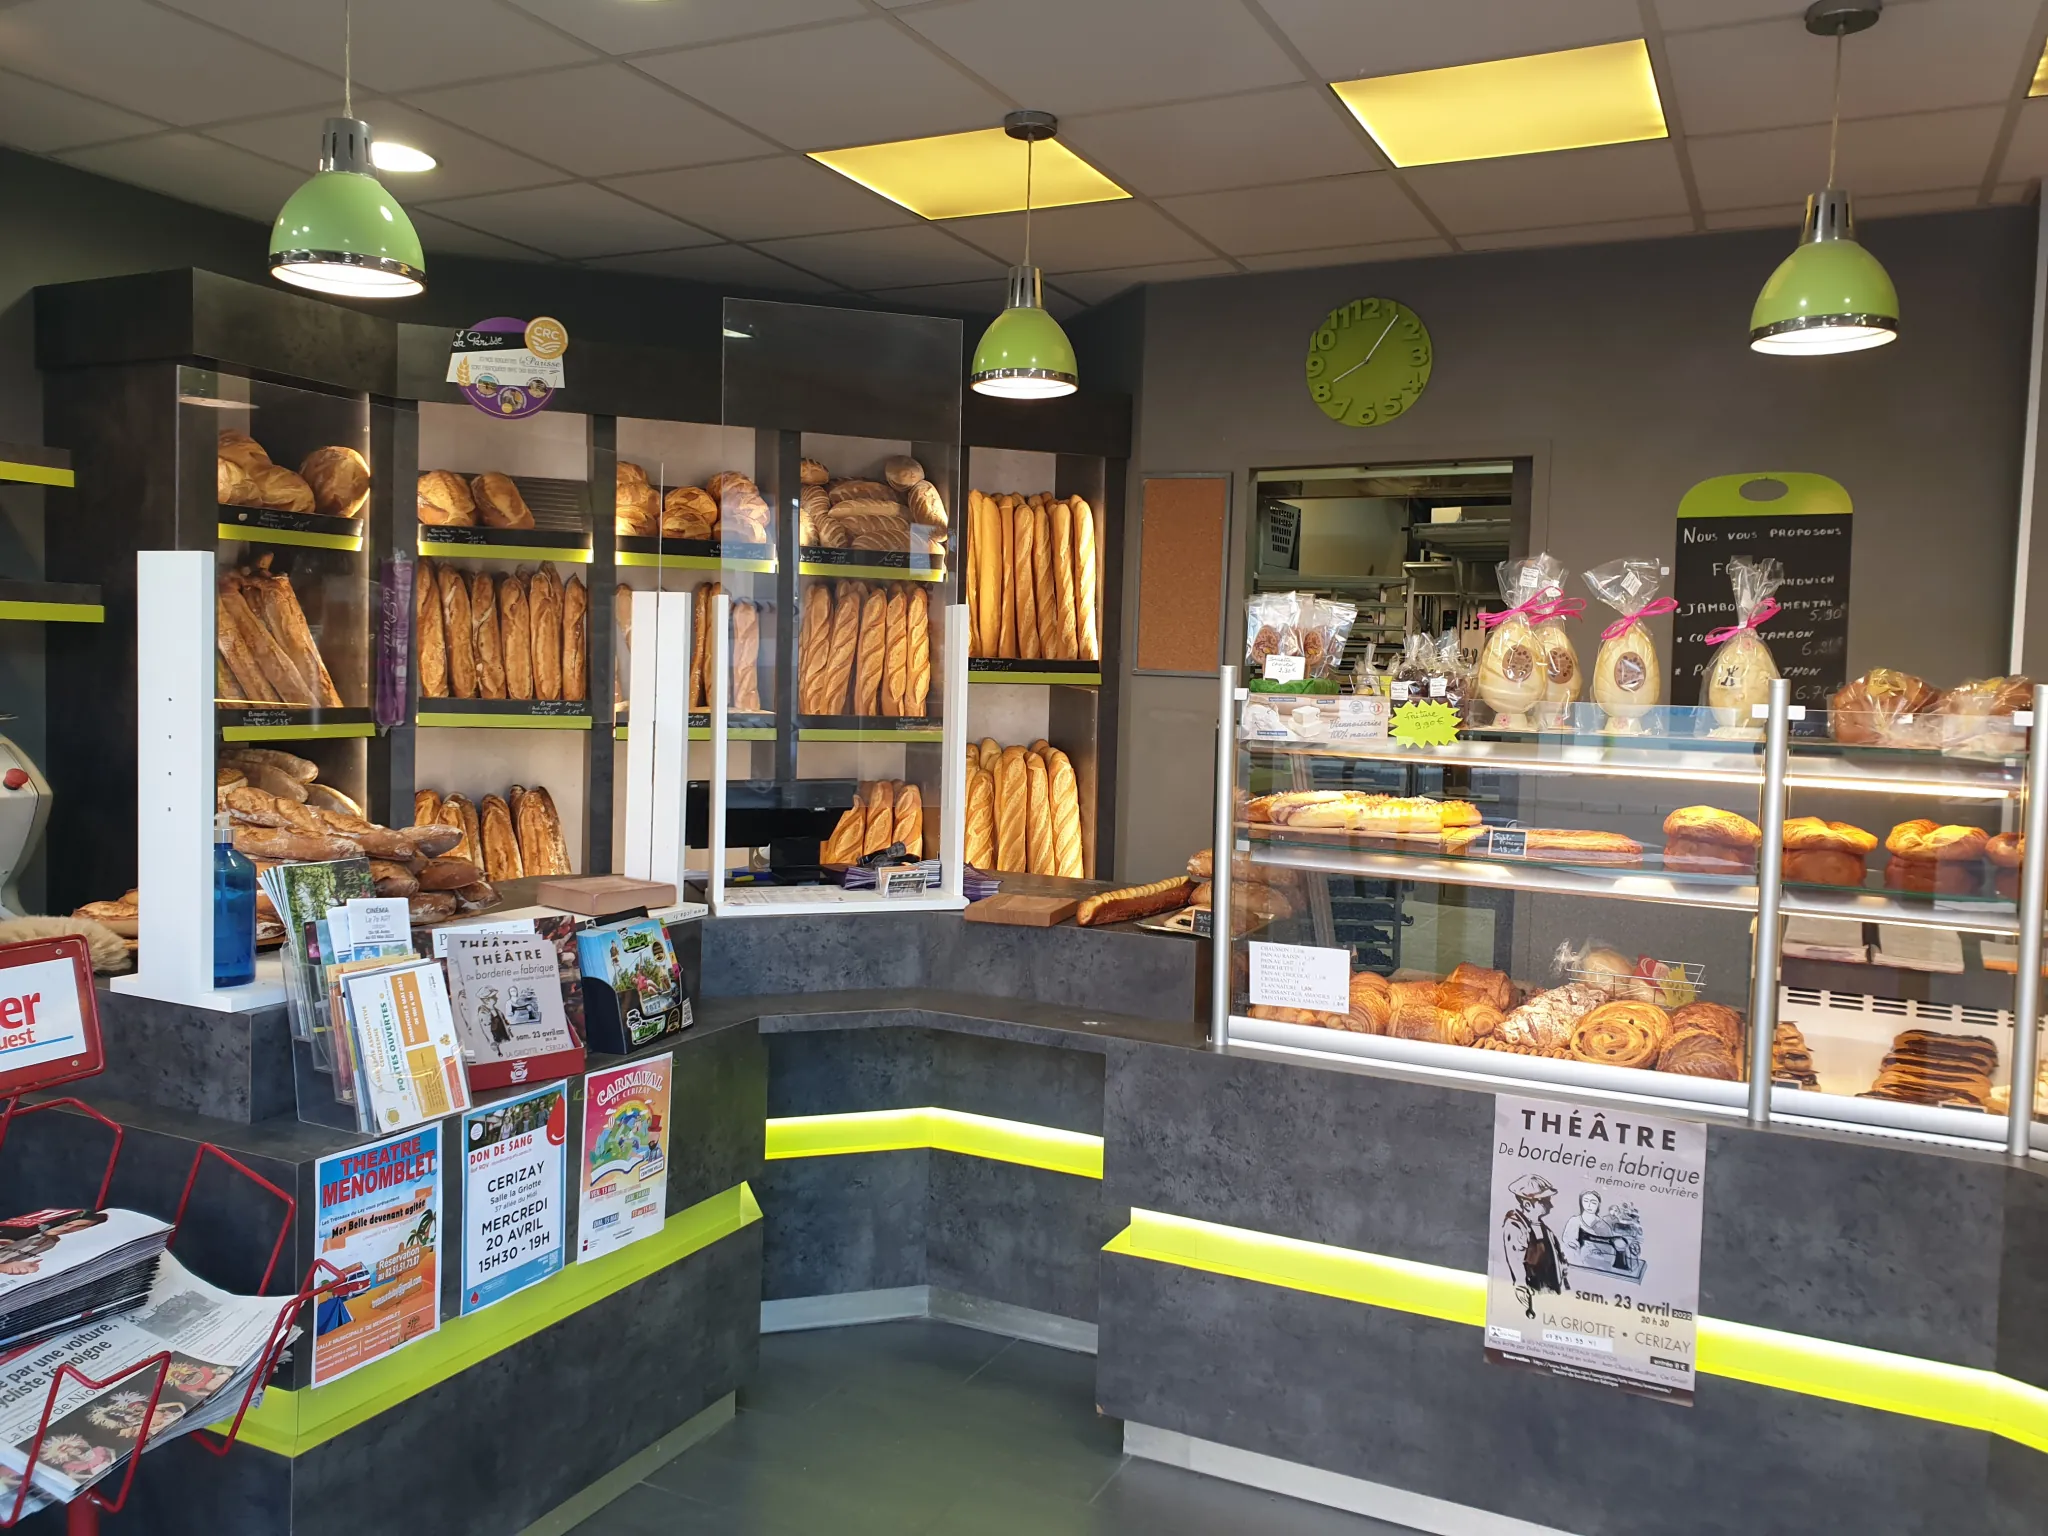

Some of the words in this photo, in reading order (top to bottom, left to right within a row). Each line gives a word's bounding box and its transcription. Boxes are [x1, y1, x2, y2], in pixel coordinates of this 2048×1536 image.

[1327, 308, 1350, 329] 11
[1351, 298, 1380, 320] 12
[1387, 301, 1398, 320] 1
[533, 327, 560, 340] CRC
[1310, 329, 1336, 352] 10
[1402, 320, 1421, 341] 2
[1306, 357, 1325, 378] 9
[1409, 346, 1429, 367] 3
[1312, 381, 1332, 403] 8
[1401, 372, 1423, 394] 4
[1332, 398, 1352, 420] 7
[1358, 402, 1377, 425] 6
[1383, 393, 1402, 416] 5
[1682, 603, 1736, 617] JAMBO
[1760, 630, 1814, 641] JAMBON
[1782, 667, 1821, 676] THON
[473, 949, 542, 966] THÉÂTRE
[475, 967, 511, 980] borderie
[520, 963, 554, 976] fabrique
[381, 1002, 396, 1052] OUVERTES
[403, 1010, 415, 1043] DIMANCHE
[516, 1033, 531, 1041] sam.
[532, 1031, 541, 1039] 23
[542, 1028, 556, 1038] avril
[597, 1071, 663, 1107] CARNAVAL
[611, 1097, 620, 1105] DE
[623, 1087, 651, 1098] CERIZAY
[1521, 1109, 1676, 1152] THÉÂTRE
[341, 1136, 420, 1176] THEATRE
[470, 1149, 490, 1165] DON
[494, 1144, 505, 1157] DE
[509, 1134, 533, 1151] SANG
[1499, 1141, 1514, 1156] De
[1518, 1138, 1597, 1169] borderie
[1600, 1160, 1614, 1173] en
[1618, 1152, 1700, 1187] fabrique
[323, 1150, 435, 1208] MENOMBLET
[487, 1160, 545, 1193] CERIZAY
[1595, 1175, 1646, 1191] mémoire
[1650, 1182, 1699, 1200] ouvrière
[490, 1192, 508, 1205] Salle
[510, 1189, 516, 1197] la
[518, 1179, 542, 1194] Griotte
[332, 1224, 346, 1239] Mer
[348, 1216, 368, 1231] Belle
[369, 1208, 403, 1225] devenant
[405, 1198, 426, 1215] agitée
[482, 1197, 548, 1236] MERCREDI
[486, 1234, 503, 1251] 20
[507, 1217, 544, 1243] AVRIL
[379, 1246, 420, 1270] Réservation
[478, 1246, 518, 1273] 15H30
[529, 1231, 550, 1251] 19H
[1575, 1289, 1608, 1306] sam.
[1614, 1294, 1632, 1310] 23
[1636, 1298, 1670, 1317] avril
[1671, 1309, 1693, 1321] 2022
[1641, 1316, 1651, 1324] 20
[1652, 1317, 1658, 1325] h
[1659, 1319, 1670, 1328] 30
[1542, 1313, 1557, 1327] LA
[1560, 1316, 1616, 1339] GRIOTTE
[1634, 1331, 1692, 1355] CERIZAY
[9, 1365, 32, 1388] par
[33, 1350, 58, 1369] une
[62, 1321, 120, 1353] voiture,
[53, 1401, 71, 1417] de
